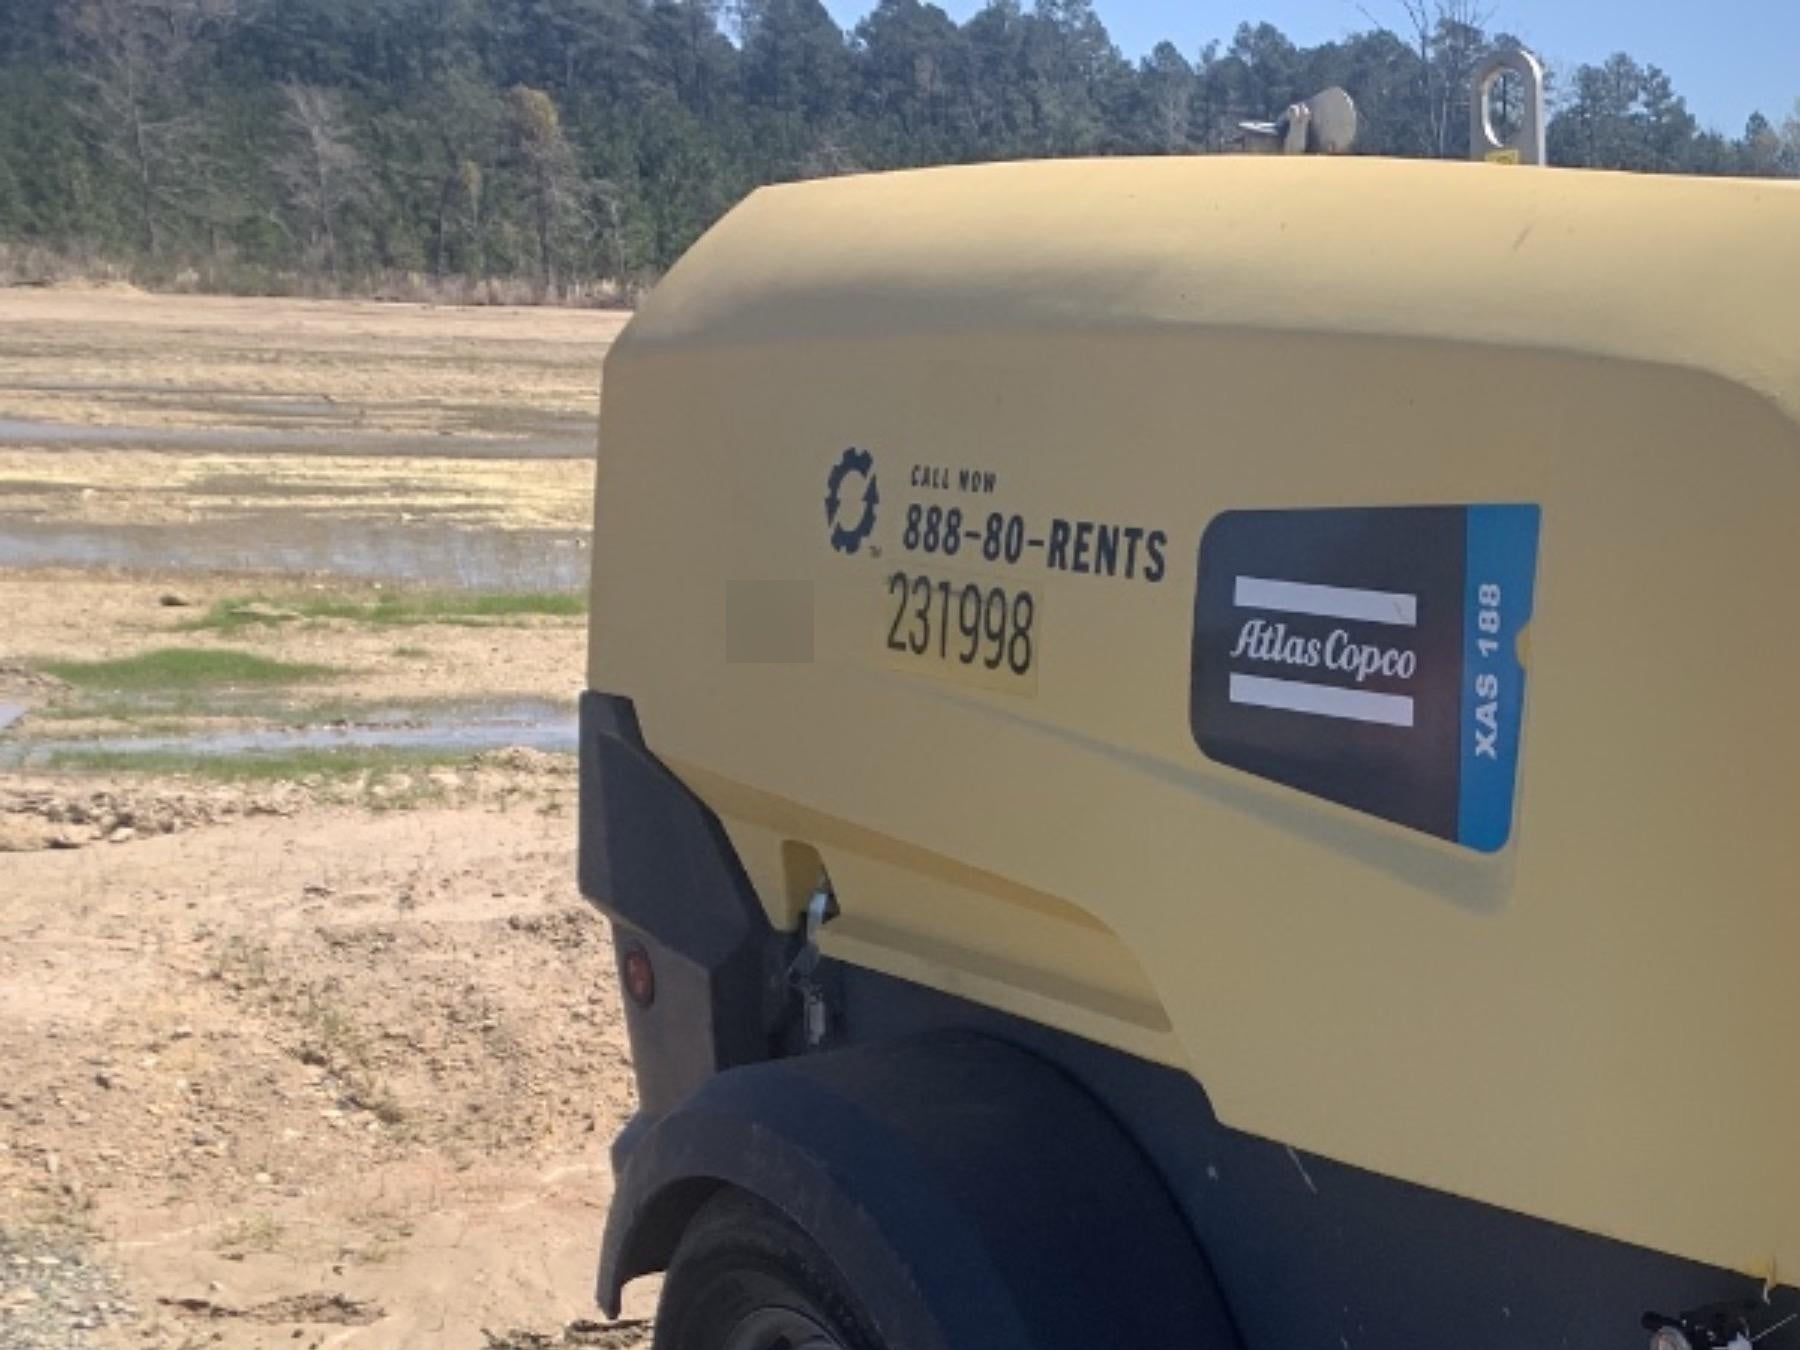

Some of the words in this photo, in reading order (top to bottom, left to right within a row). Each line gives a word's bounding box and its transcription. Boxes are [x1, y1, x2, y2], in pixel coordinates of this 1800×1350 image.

[911, 463, 950, 490] CALL
[958, 467, 997, 494] NOW
[902, 502, 1168, 583] 888-80-RENTS
[885, 571, 1035, 675] 231998
[1229, 618, 1322, 667] Atlas
[1324, 628, 1416, 682] Copco
[1477, 583, 1502, 657] 188
[1474, 673, 1499, 760] XAS
